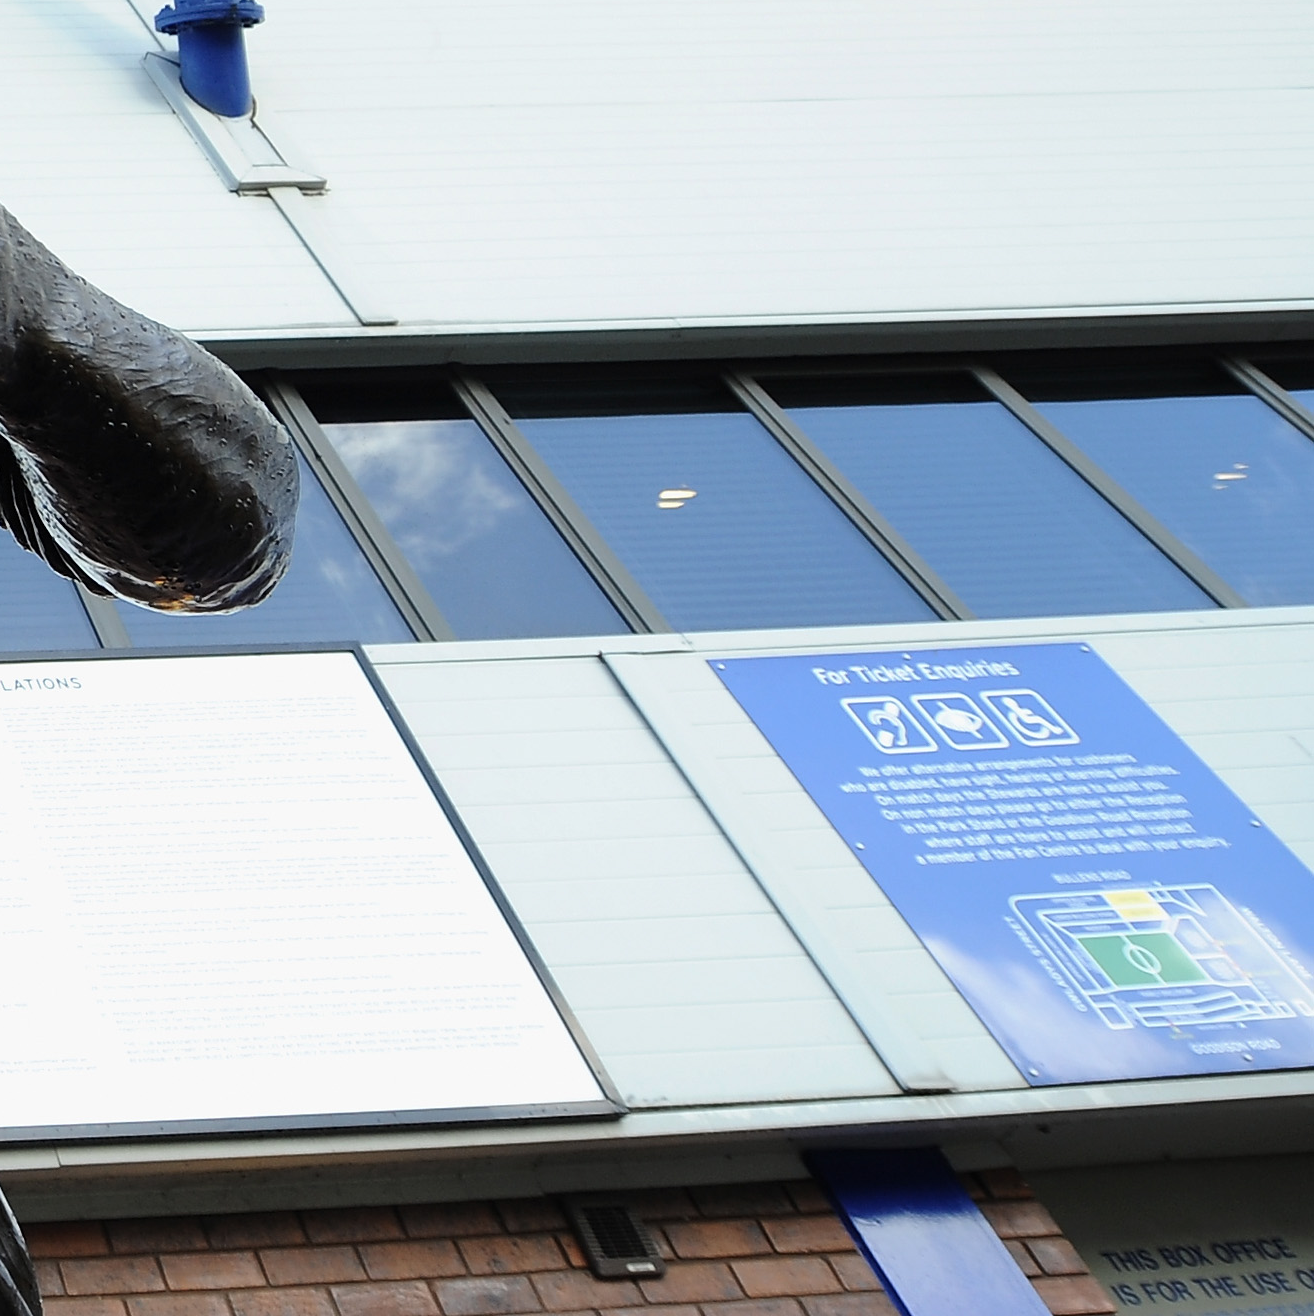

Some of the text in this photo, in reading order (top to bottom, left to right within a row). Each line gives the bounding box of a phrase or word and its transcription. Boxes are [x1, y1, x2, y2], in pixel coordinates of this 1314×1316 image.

[812, 660, 1020, 685] For Ticket Enquiries
[859, 753, 1136, 777] We offer alternative arrangements for customers
[840, 782, 866, 793] who
[867, 781, 888, 792] are
[938, 776, 971, 786] have
[1004, 770, 1054, 783] hearing
[1051, 771, 1066, 782] or
[1065, 769, 1117, 781] learning
[875, 793, 896, 806] On
[896, 792, 934, 805] match
[934, 791, 964, 803] days
[963, 789, 986, 801] the
[984, 787, 1042, 799] Stewards
[1041, 786, 1063, 797] are
[1061, 784, 1092, 795] here
[1090, 783, 1107, 793] to
[1106, 781, 1142, 793] assist
[881, 793, 1187, 821] On non match days please go to either the Reception
[915, 822, 938, 834] the
[937, 820, 969, 833] Park
[967, 818, 1006, 831] Stand
[1006, 818, 1020, 830] or
[1019, 816, 1044, 828] the
[1097, 811, 1132, 822] Road
[1127, 808, 1193, 821] Reception
[925, 837, 963, 849] where
[963, 834, 993, 847] staff
[994, 833, 1015, 845] are
[1014, 831, 1051, 844] there
[1048, 830, 1066, 841] to
[1065, 827, 1103, 840] assist
[1101, 826, 1127, 838] and
[1147, 822, 1195, 835] contact
[915, 853, 927, 866] a
[925, 851, 976, 864] member
[976, 849, 993, 861] of
[990, 848, 1015, 860] the
[1014, 846, 1040, 859] Fan
[1036, 844, 1081, 858] Centre
[1078, 843, 1097, 855] to
[1095, 841, 1125, 854] deal
[1123, 839, 1153, 852] with
[1151, 839, 1180, 852] your
[1052, 869, 1131, 884] BULLENS ROAD
[1003, 915, 1043, 957] STREET
[1246, 1038, 1280, 1051] ROAD
[1101, 1238, 1296, 1272] THIS BOX OFFICE
[1111, 1284, 1141, 1306] IS
[1141, 1280, 1195, 1303] FOR
[1193, 1275, 1244, 1299] THE
[1242, 1271, 1296, 1296] USE
